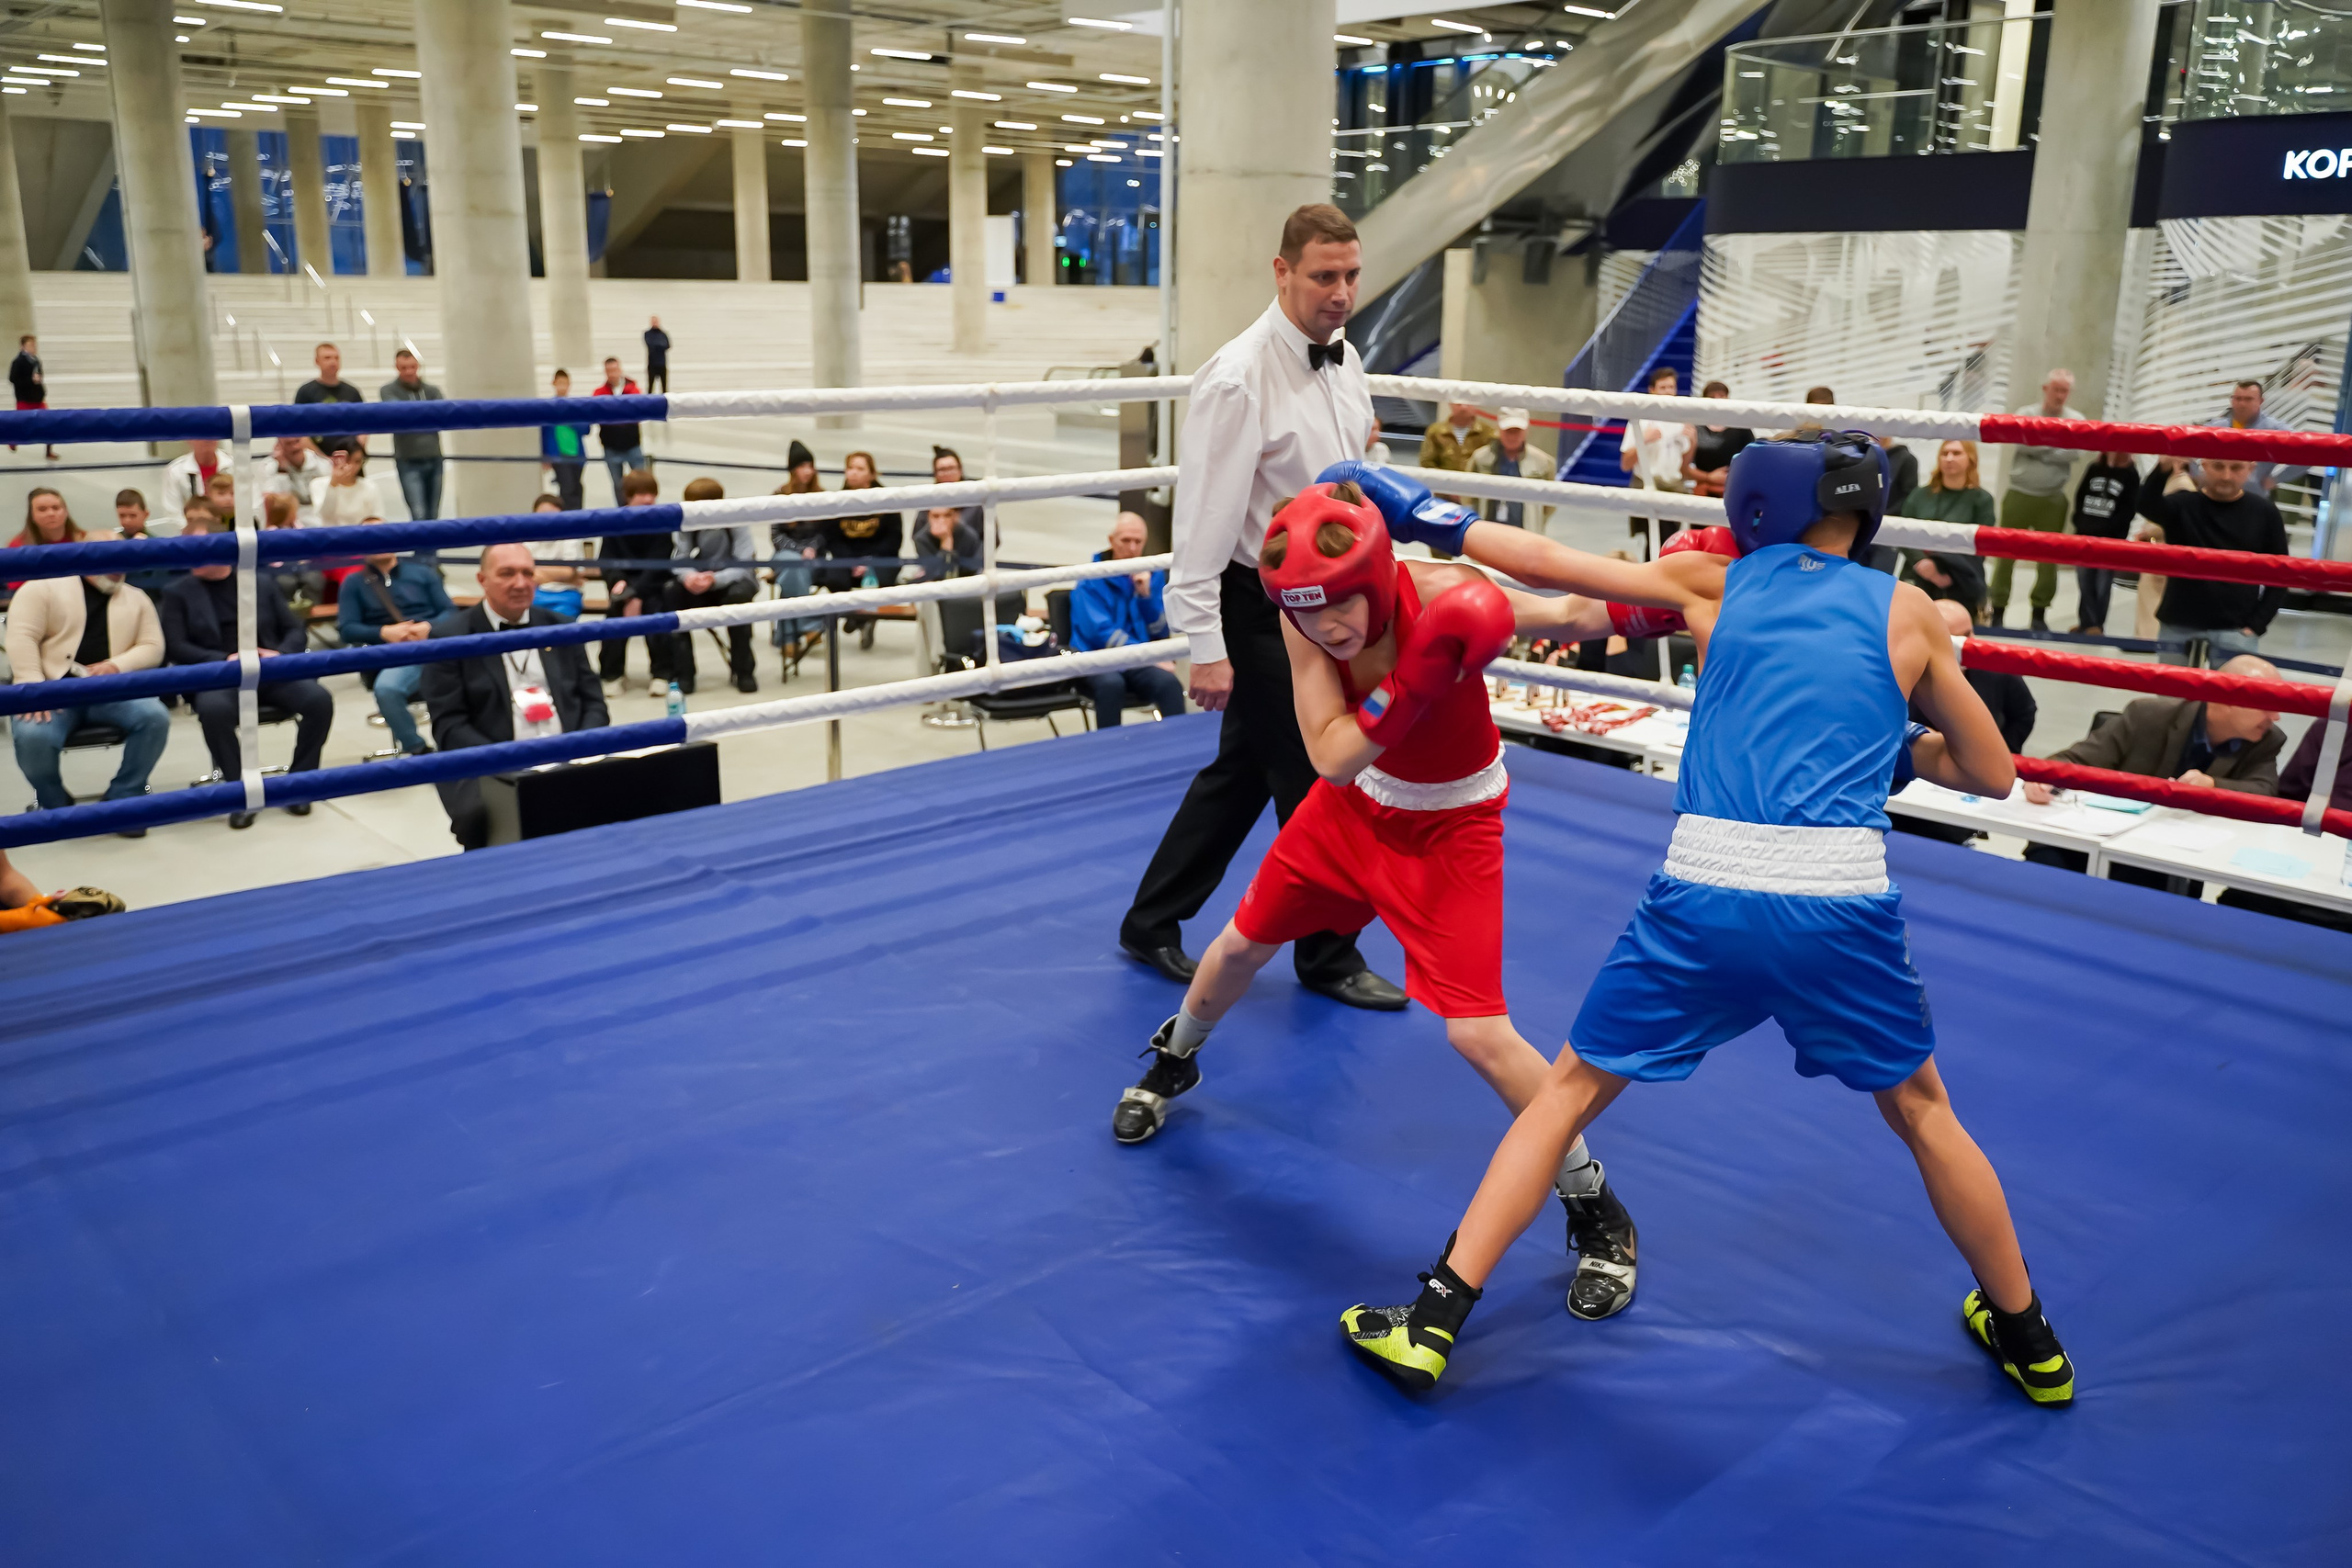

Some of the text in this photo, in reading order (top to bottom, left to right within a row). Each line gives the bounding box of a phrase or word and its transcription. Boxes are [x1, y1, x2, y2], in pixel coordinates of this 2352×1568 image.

[1283, 592, 1322, 603] TOP TEN
[1589, 1260, 1605, 1269] NIKE
